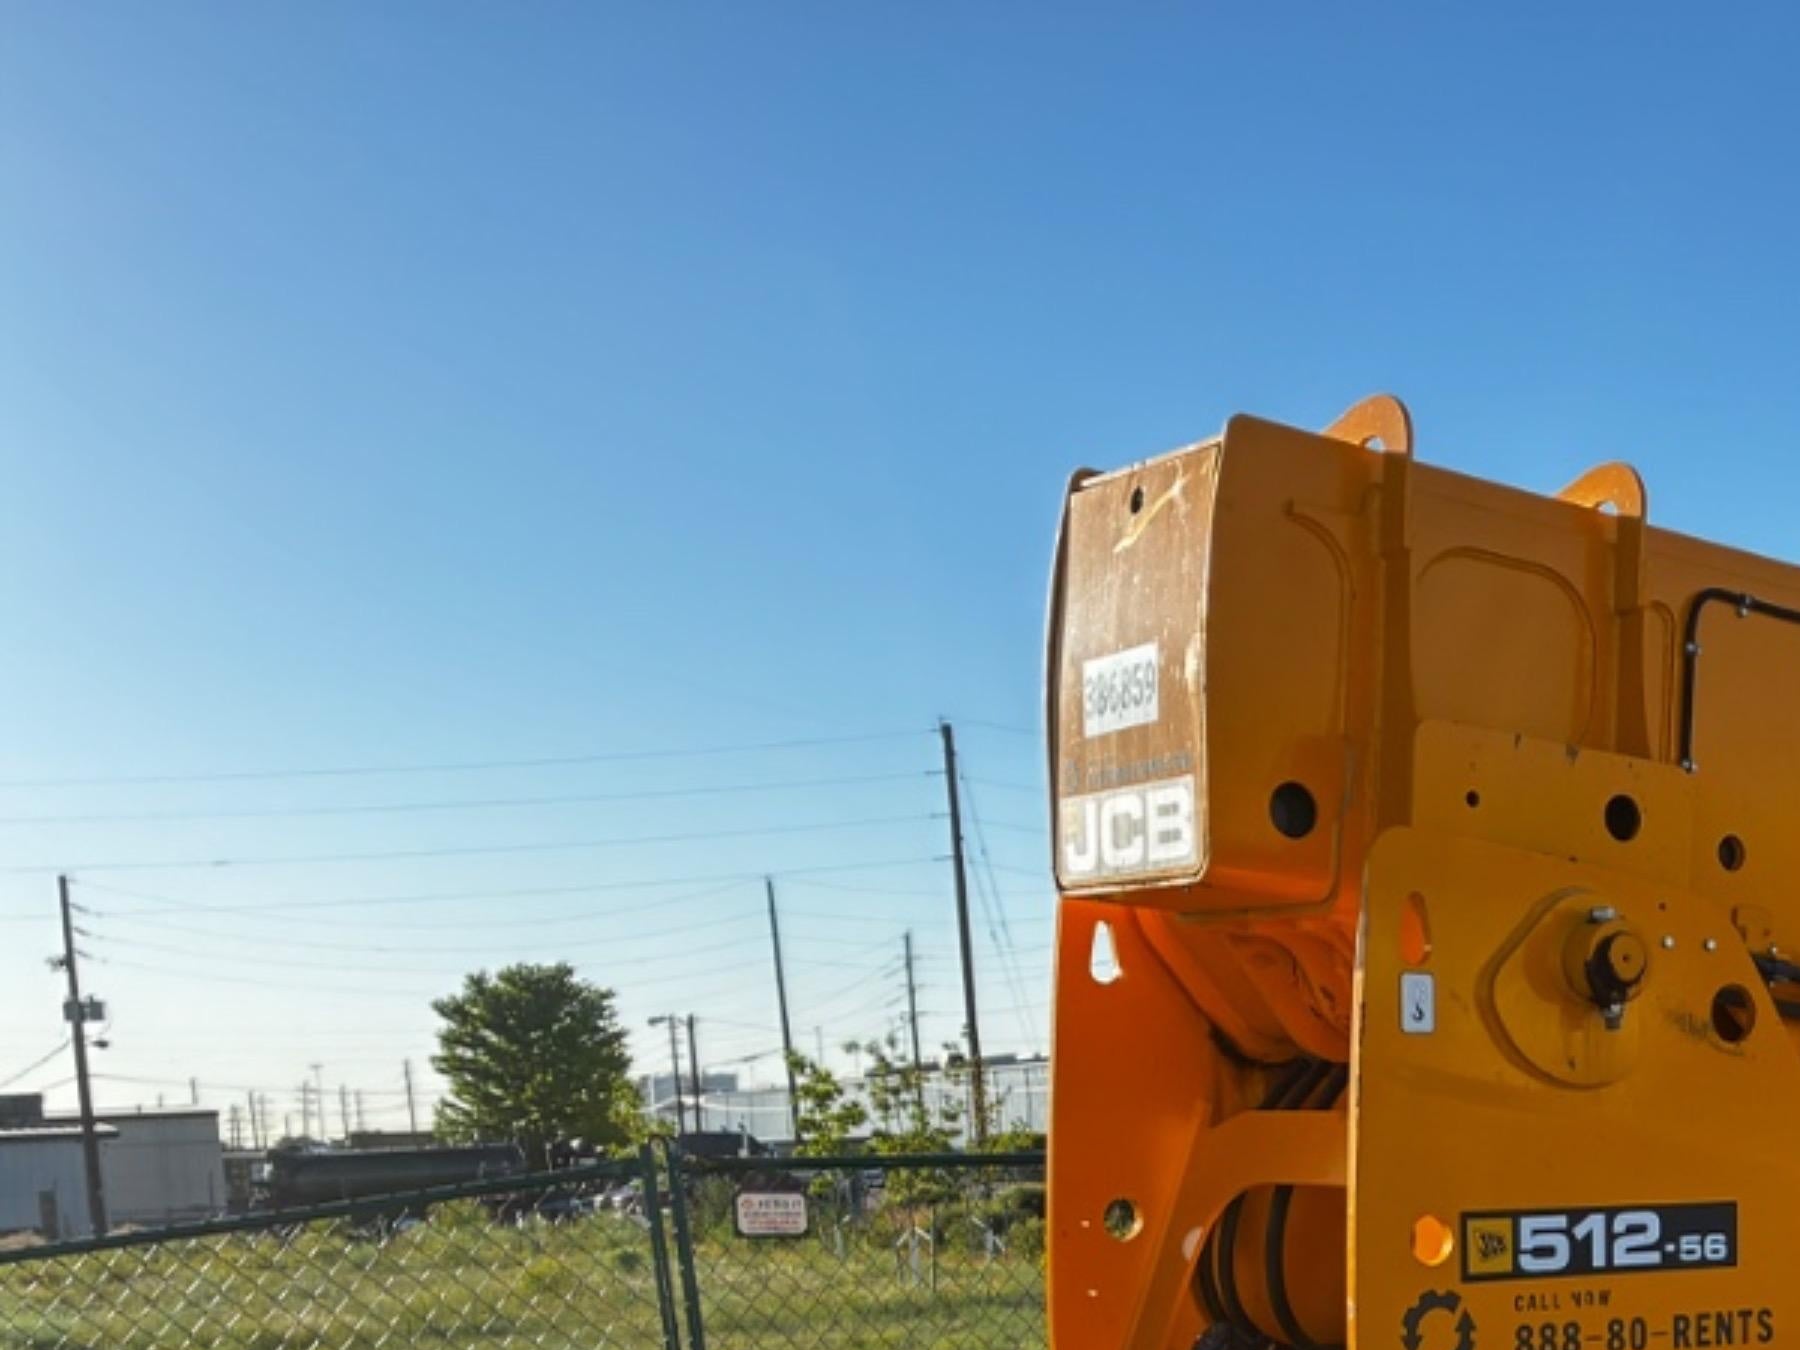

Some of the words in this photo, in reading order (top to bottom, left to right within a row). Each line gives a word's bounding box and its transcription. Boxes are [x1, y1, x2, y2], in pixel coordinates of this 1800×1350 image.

[1085, 661, 1155, 717] 386859
[1066, 784, 1192, 871] JCB
[1518, 1211, 1729, 1272] 512-56
[1514, 1292, 1561, 1312] CALL
